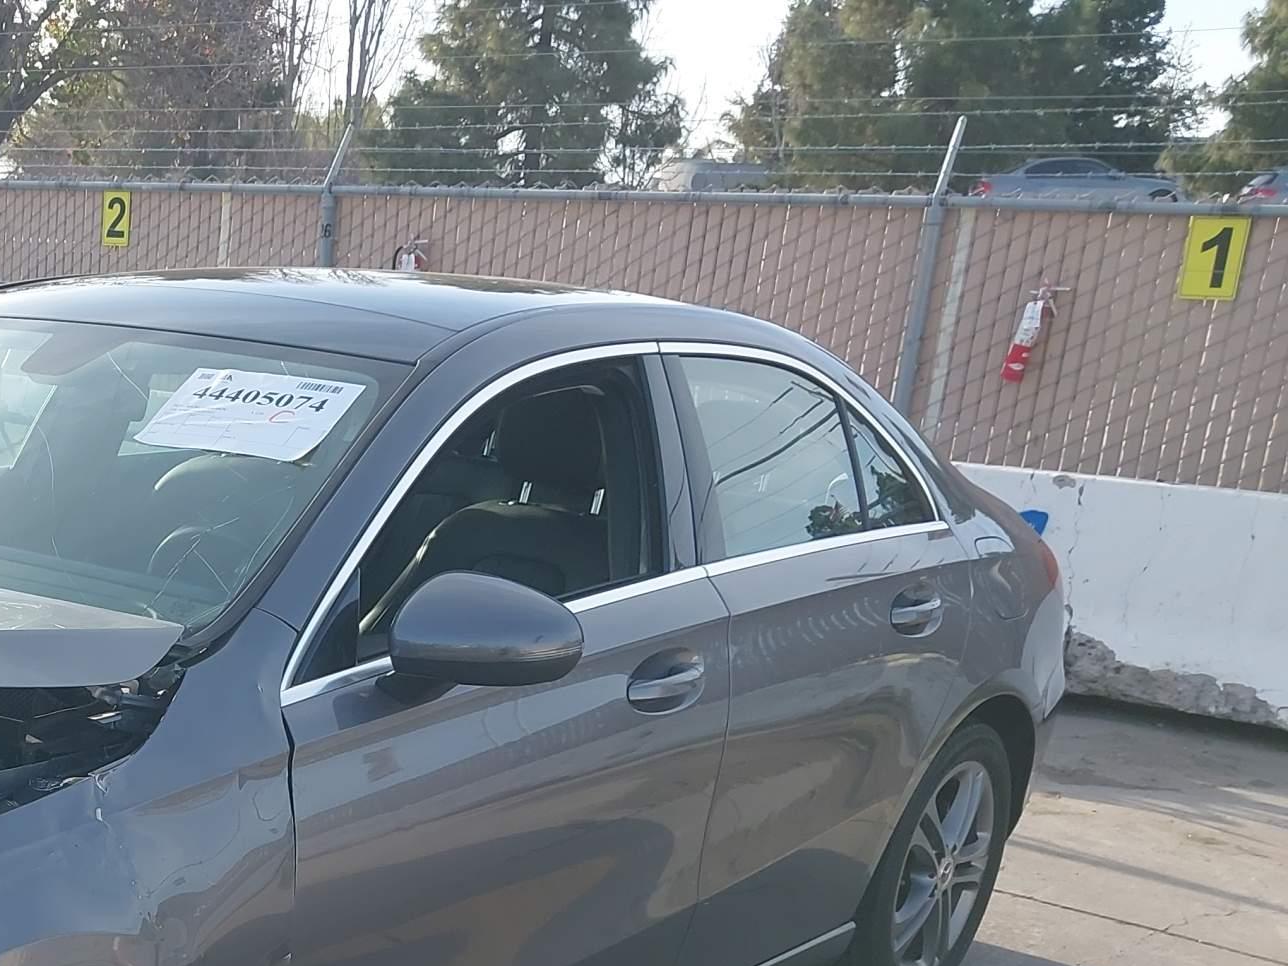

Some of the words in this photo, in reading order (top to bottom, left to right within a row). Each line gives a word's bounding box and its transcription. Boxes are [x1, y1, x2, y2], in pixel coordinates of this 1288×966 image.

[106, 197, 126, 238] 2
[1200, 227, 1234, 288] 1
[193, 386, 330, 412] 44405074
